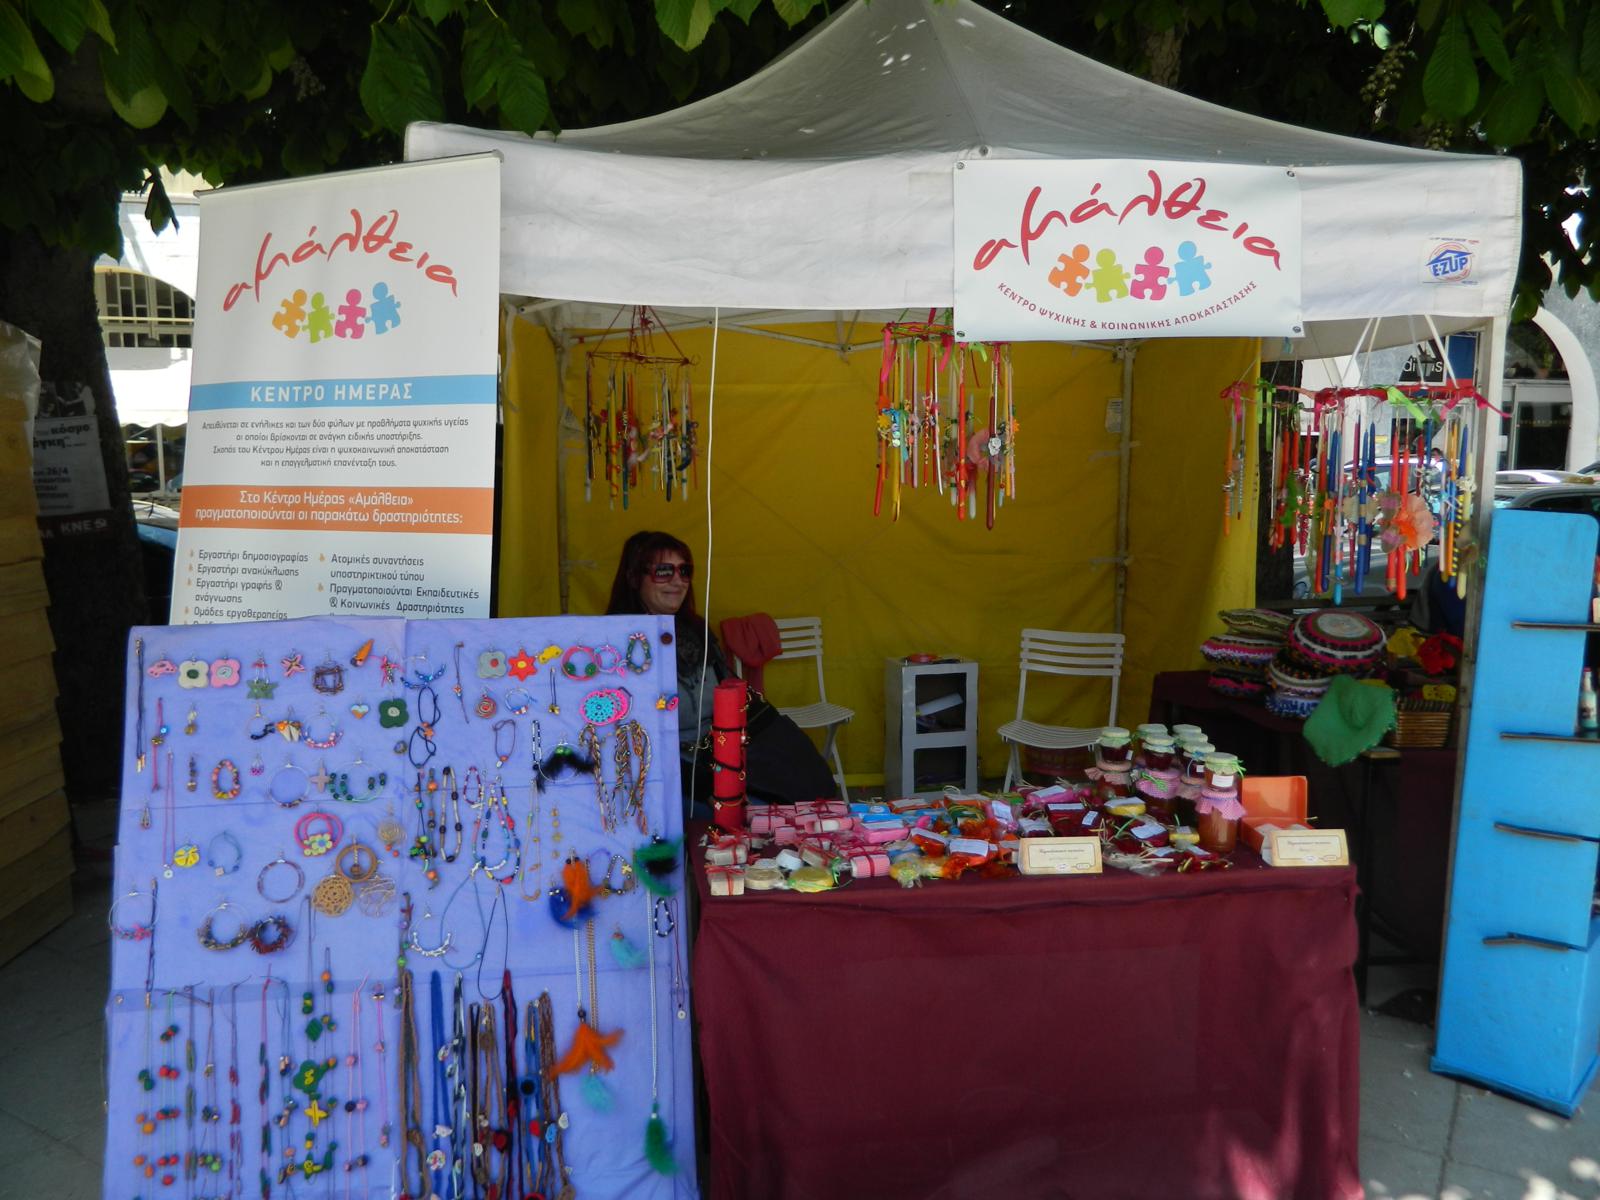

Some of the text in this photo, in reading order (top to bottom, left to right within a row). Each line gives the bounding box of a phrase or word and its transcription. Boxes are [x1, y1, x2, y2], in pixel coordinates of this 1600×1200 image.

[998, 280, 1258, 330] ΚΕΝΤΡΟ ΨΥΧΙΚΗΣ & ΚΟΙΝΩΝΙΚΗΣ ΑΠΟΚΑΤΑΣΤΑΣΗΣ
[251, 383, 413, 402] ΚΕΝΤΡΟ ΗΜΕΡΑΣ
[240, 490, 260, 503] Στο
[263, 490, 301, 506] Κέντρο
[303, 491, 345, 507] Ημέρας
[195, 506, 463, 526] πραγματοποιούνται οι παρακάτω δραστηριότητες:
[198, 549, 309, 564] Εργαστήρι δημοσιογραφίας
[331, 553, 424, 567] Ατομικές συναντήσεις
[197, 563, 300, 577] Εργαστήρι ανακύκλωσης
[330, 569, 425, 582] υποστηρικτικού τύπου
[196, 577, 238, 591] Εργαστήρι
[240, 580, 273, 592] γραφής
[329, 583, 479, 600] Πραγματοποιούνται Εκπαιδευτικές
[195, 592, 243, 604] ανάγνωσης
[194, 606, 224, 618] Ομάδες
[340, 598, 390, 610] Κοινωνικές
[396, 600, 464, 614] Δραστηριότητες
